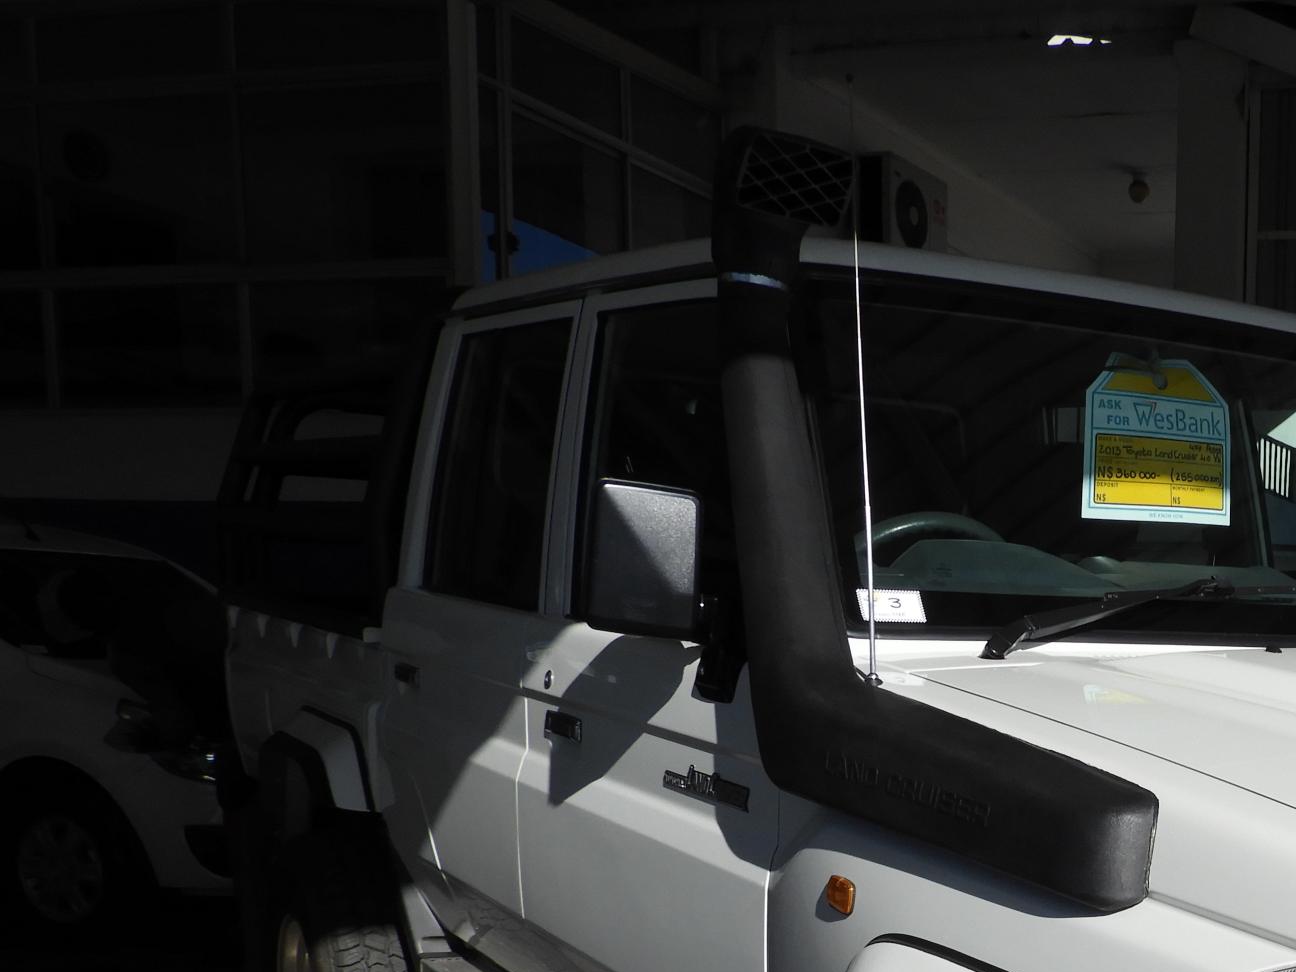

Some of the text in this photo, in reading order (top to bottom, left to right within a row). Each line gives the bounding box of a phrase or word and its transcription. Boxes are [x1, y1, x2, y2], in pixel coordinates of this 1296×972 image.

[1098, 399, 1122, 411] ASK
[1106, 415, 1130, 426] FOR
[1133, 402, 1222, 436] WesBank
[823, 750, 992, 828] LAND CRUISER
